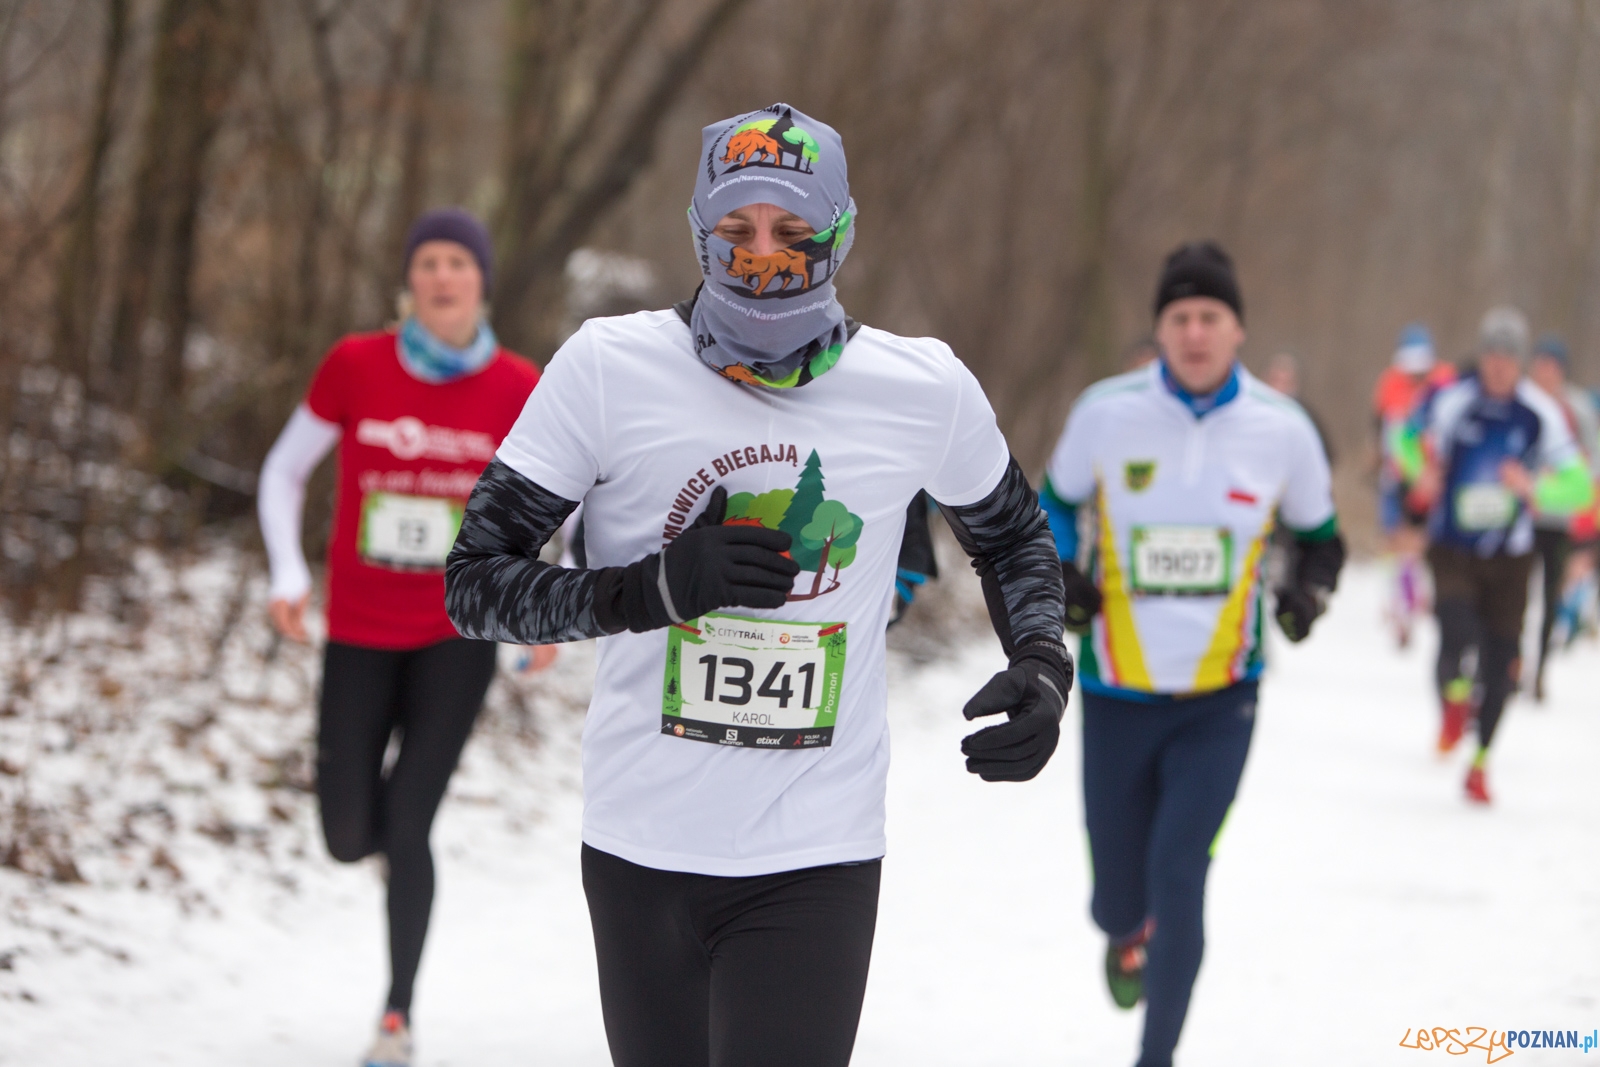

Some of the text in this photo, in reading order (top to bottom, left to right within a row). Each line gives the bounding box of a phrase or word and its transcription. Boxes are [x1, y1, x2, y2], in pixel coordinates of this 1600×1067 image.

[661, 444, 798, 550] MOWICE BIEGAJĄ
[698, 654, 816, 709] 1341
[824, 672, 838, 714] Poznań
[732, 711, 775, 726] KAROL
